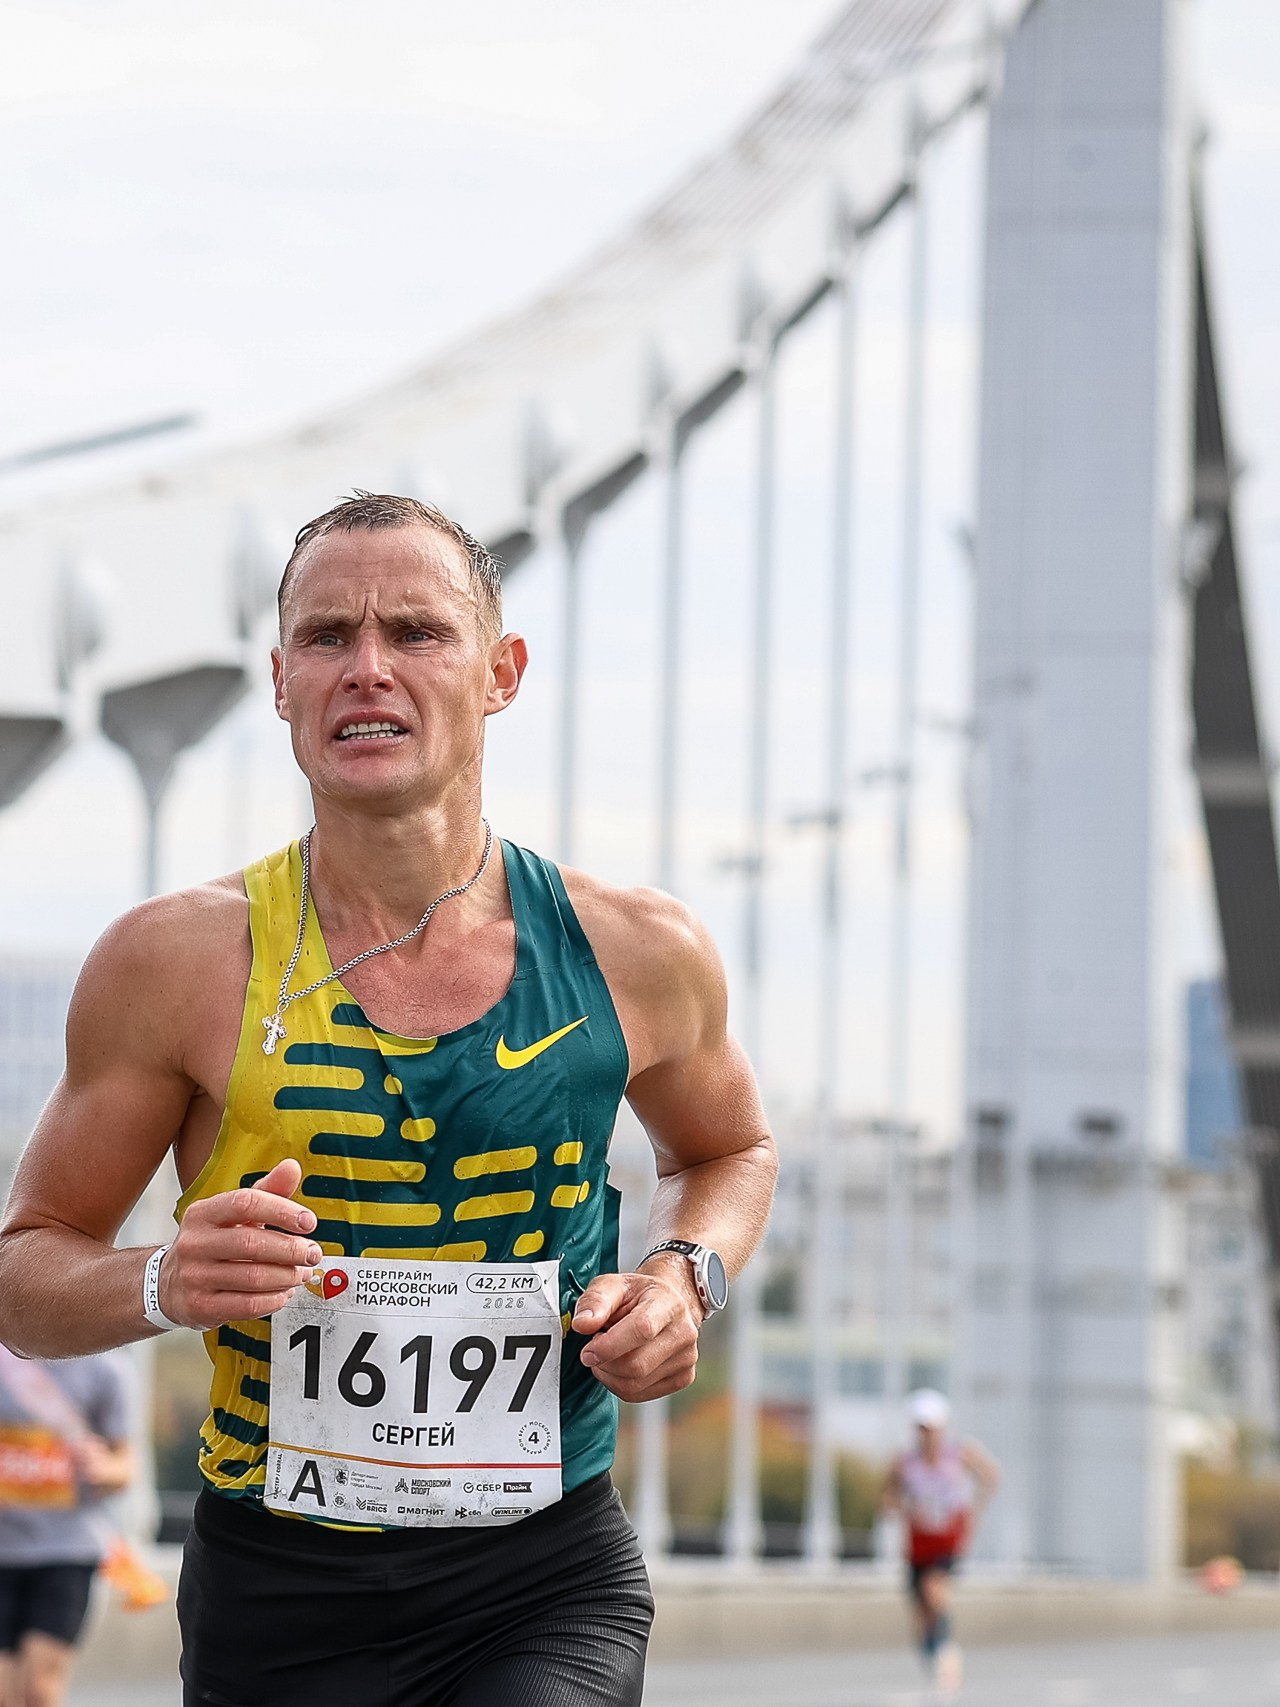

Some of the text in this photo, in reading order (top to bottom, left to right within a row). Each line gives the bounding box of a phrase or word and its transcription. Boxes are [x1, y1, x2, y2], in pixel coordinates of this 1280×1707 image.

[357, 1269, 432, 1281] СБЕРПРАЙМ
[356, 1281, 458, 1295] МОСКОВСКИЙ
[475, 1277, 534, 1291] 42,2 КМ
[355, 1294, 431, 1307] МАРАФОН
[482, 1297, 525, 1309] 2026
[289, 1324, 552, 1414] 16197
[372, 1421, 456, 1447] СЕРГЕЙ
[528, 1431, 540, 1444] 4
[411, 1478, 451, 1488] МОСКОВСКИЙ
[476, 1483, 502, 1492] СБЕР
[411, 1487, 430, 1496] СПОРТ
[366, 1505, 388, 1513] BRICS
[406, 1507, 446, 1516] магнит
